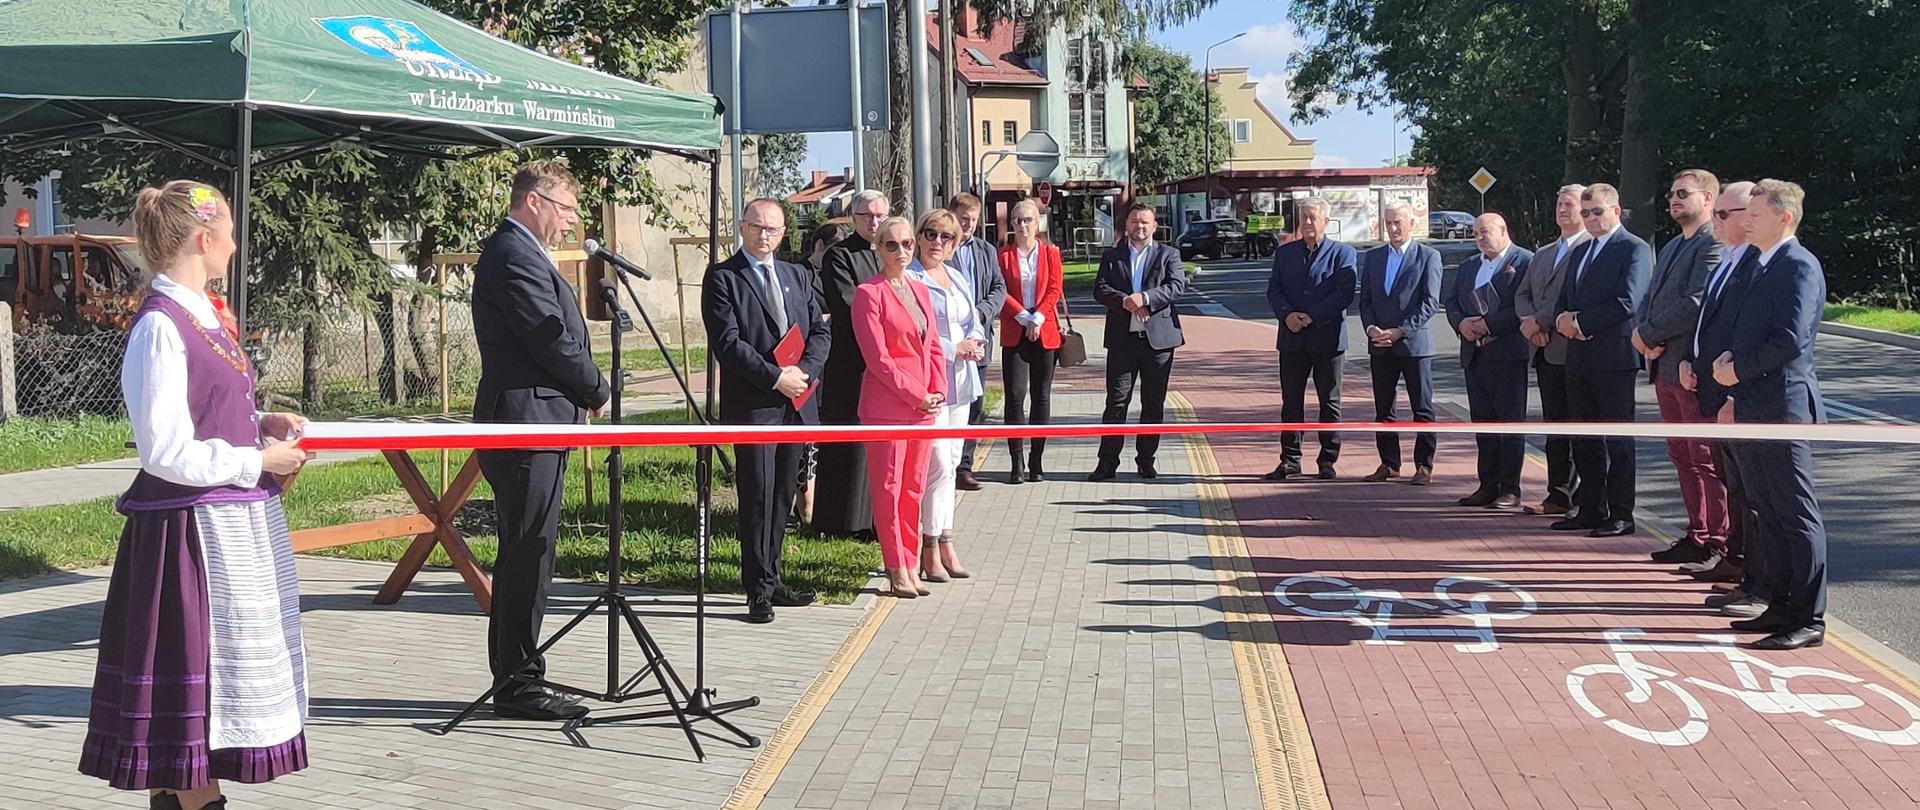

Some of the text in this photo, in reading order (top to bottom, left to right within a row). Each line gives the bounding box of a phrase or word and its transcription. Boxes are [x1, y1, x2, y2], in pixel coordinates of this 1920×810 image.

[408, 92, 425, 106] w
[428, 88, 514, 115] Lidzbarku
[522, 99, 615, 129] Warmińskim
